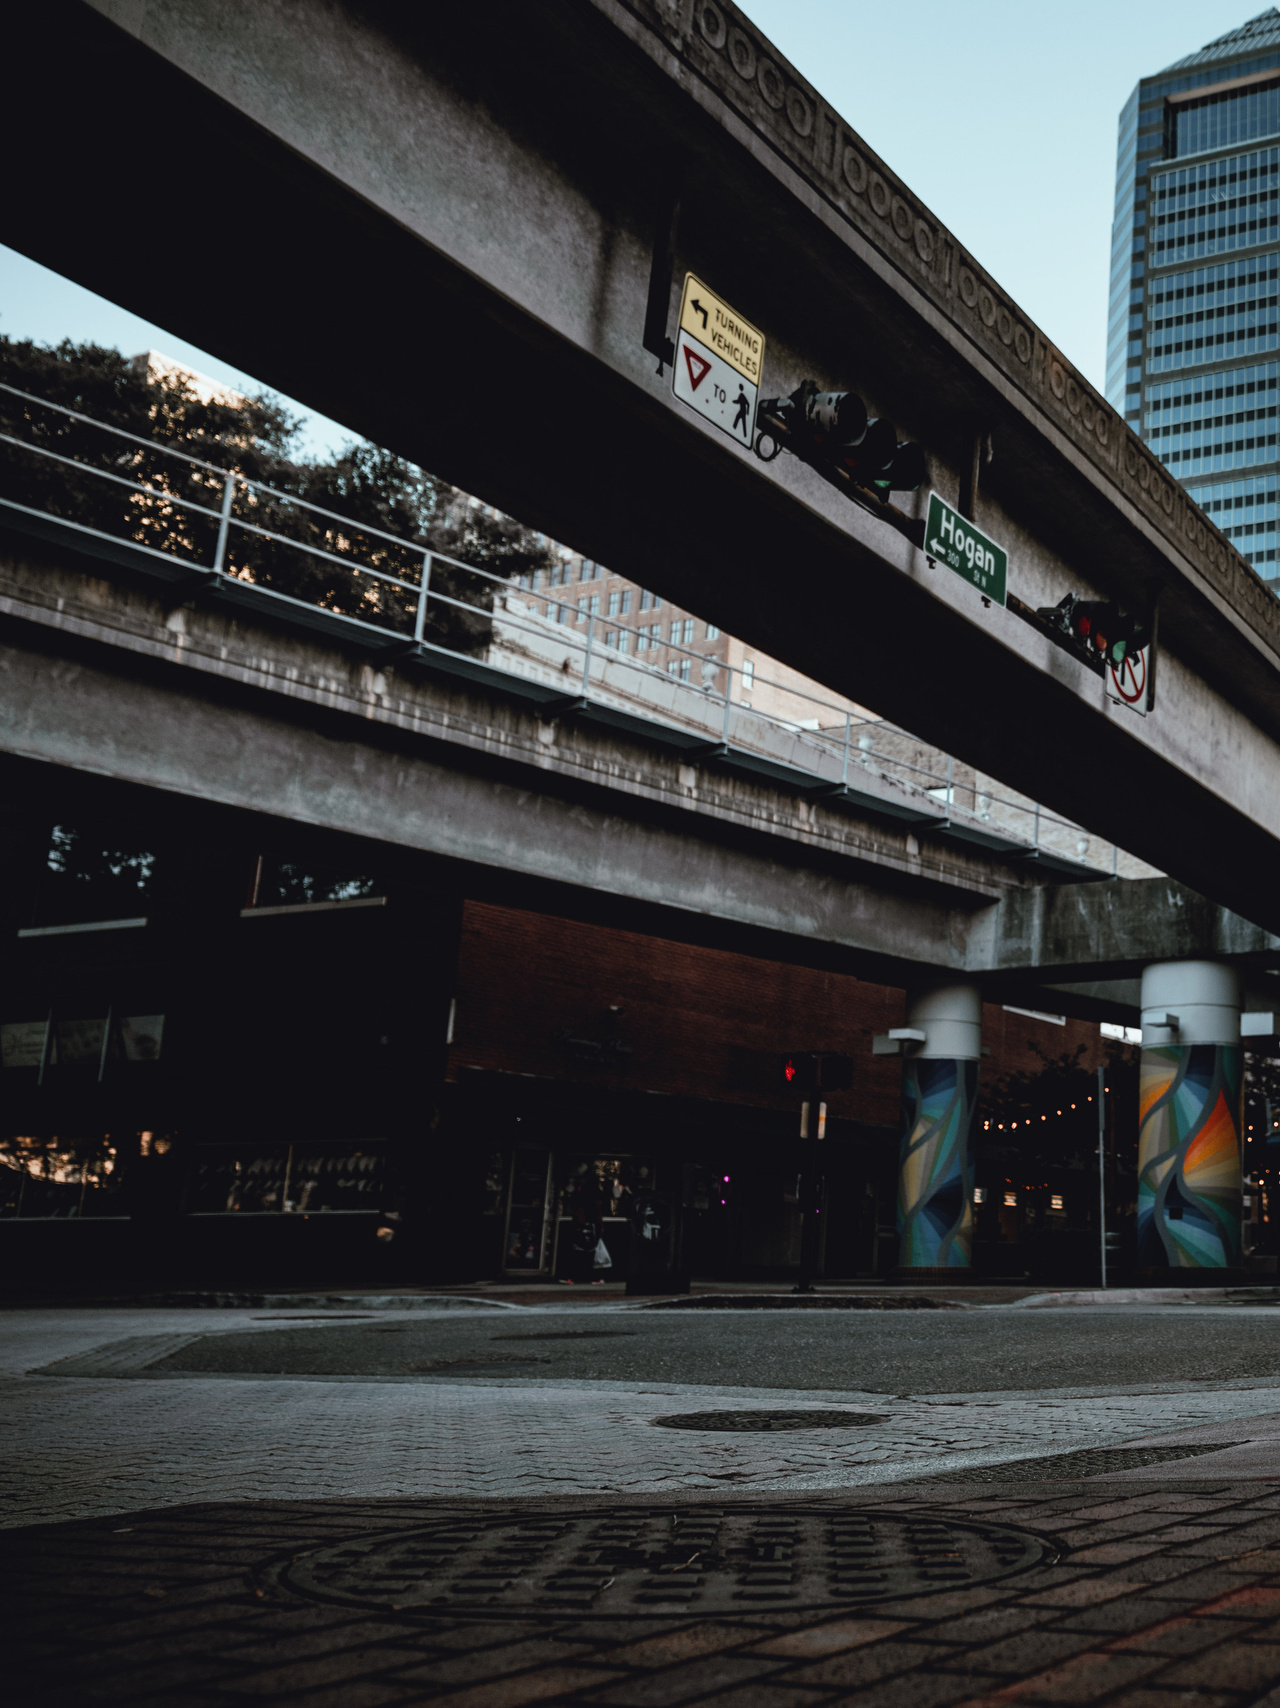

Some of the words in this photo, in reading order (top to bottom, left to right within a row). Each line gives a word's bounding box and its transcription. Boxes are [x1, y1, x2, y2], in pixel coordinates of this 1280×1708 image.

[711, 328, 757, 376] VEHICLES
[715, 308, 758, 353] TURNING
[713, 383, 726, 403] TO
[940, 507, 995, 577] Hogan
[946, 549, 960, 568] 300
[973, 569, 980, 584] St
[981, 576, 987, 588] N
